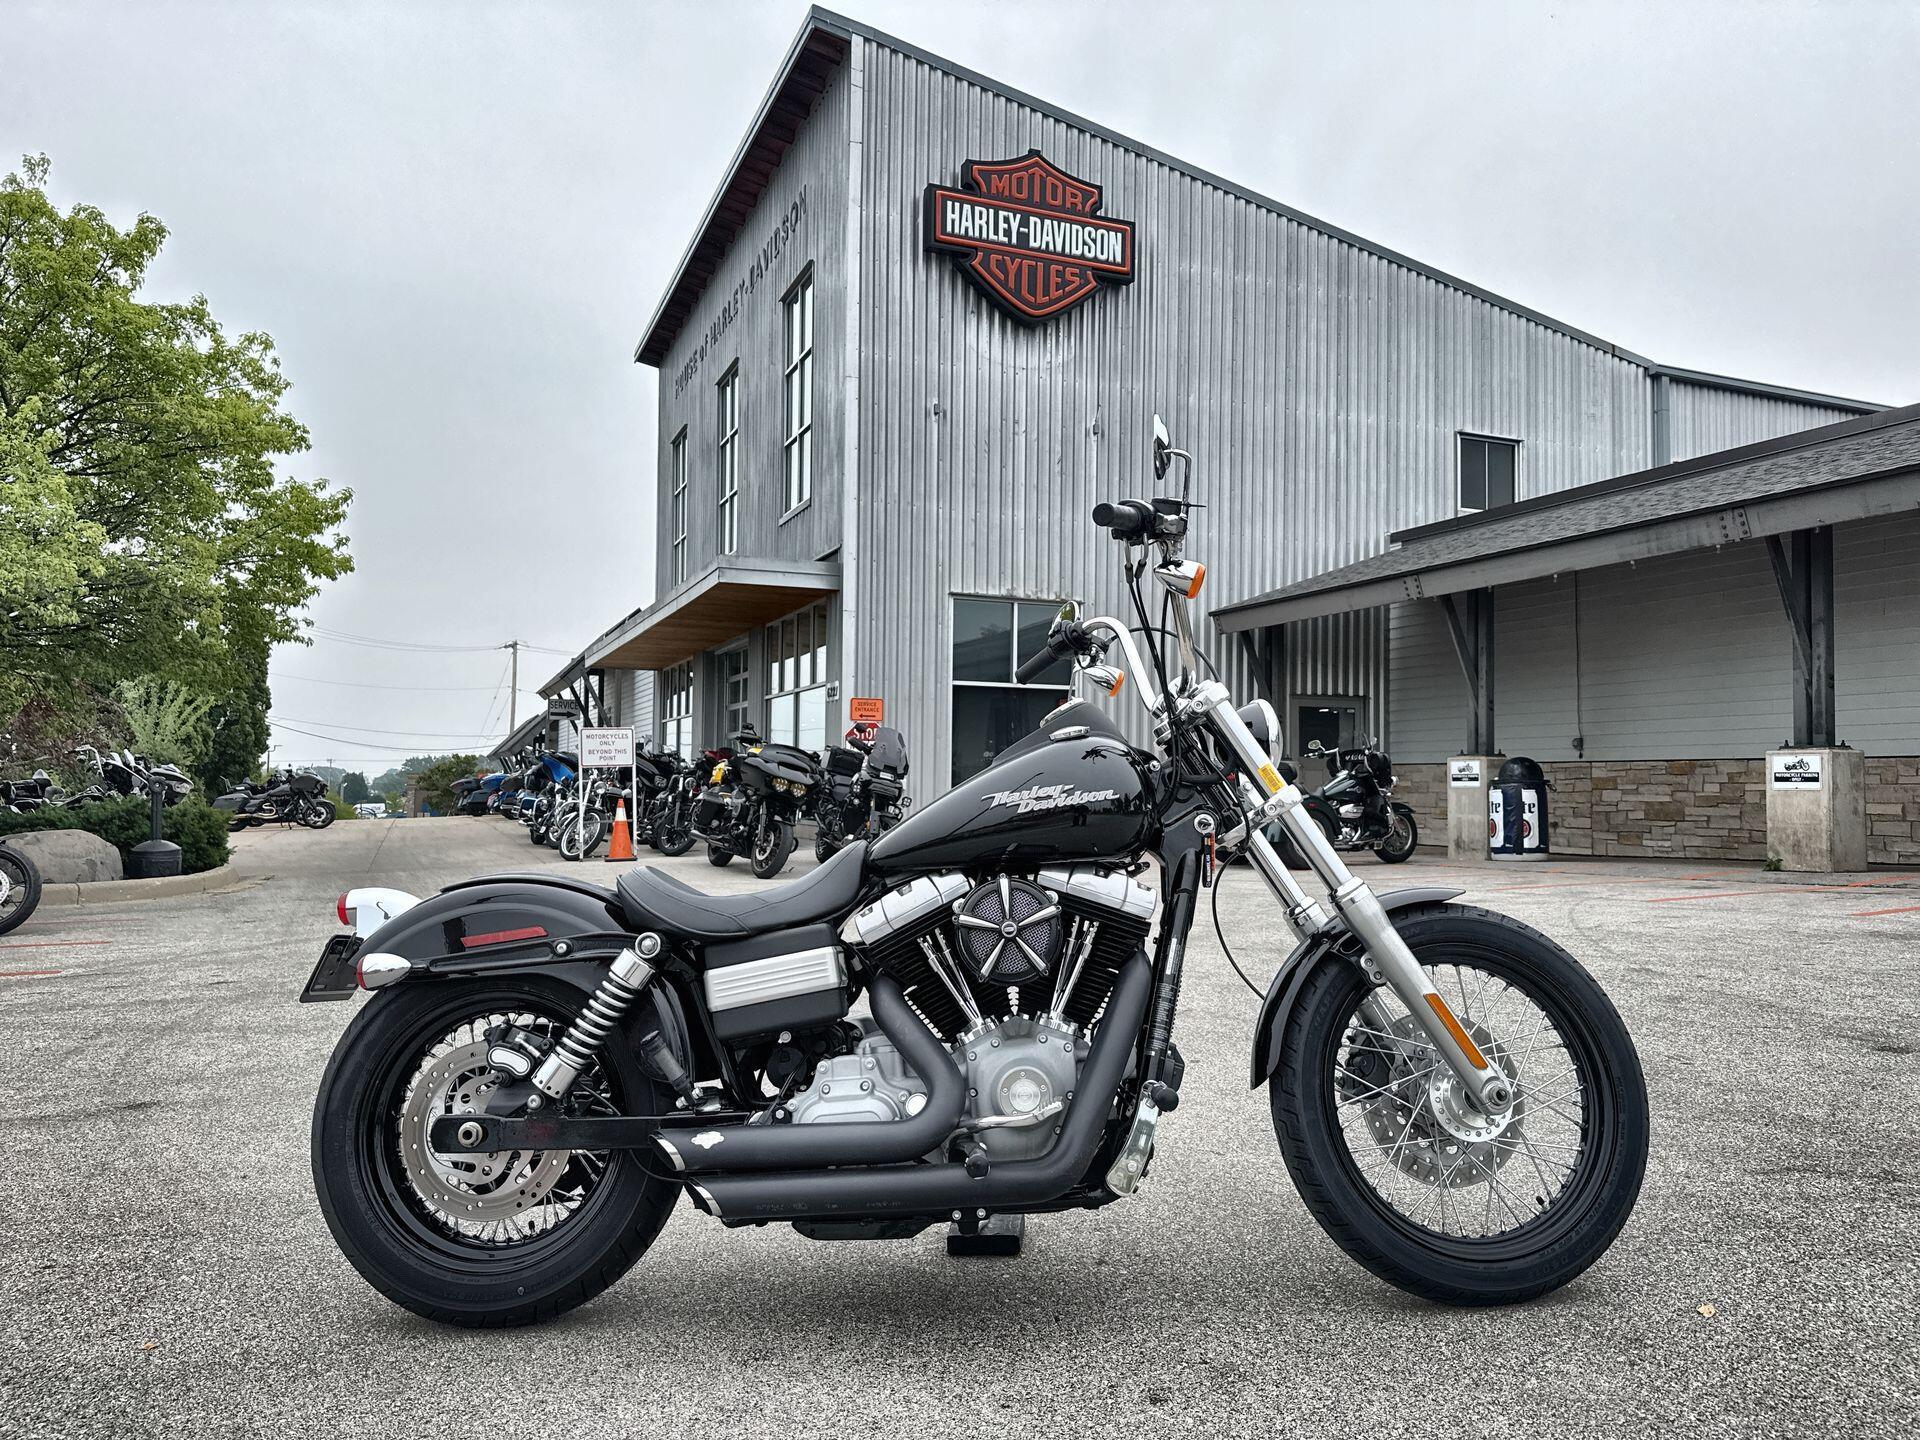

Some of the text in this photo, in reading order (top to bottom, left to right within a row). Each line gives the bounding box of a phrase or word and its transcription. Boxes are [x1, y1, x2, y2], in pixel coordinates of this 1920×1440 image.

[991, 167, 1083, 213] MOTOR
[946, 201, 1122, 264] HARLEY-DAVIDSON
[989, 254, 1081, 305] CYCLES
[550, 701, 579, 710] SERVICE
[1006, 789, 1120, 814] Davidson
